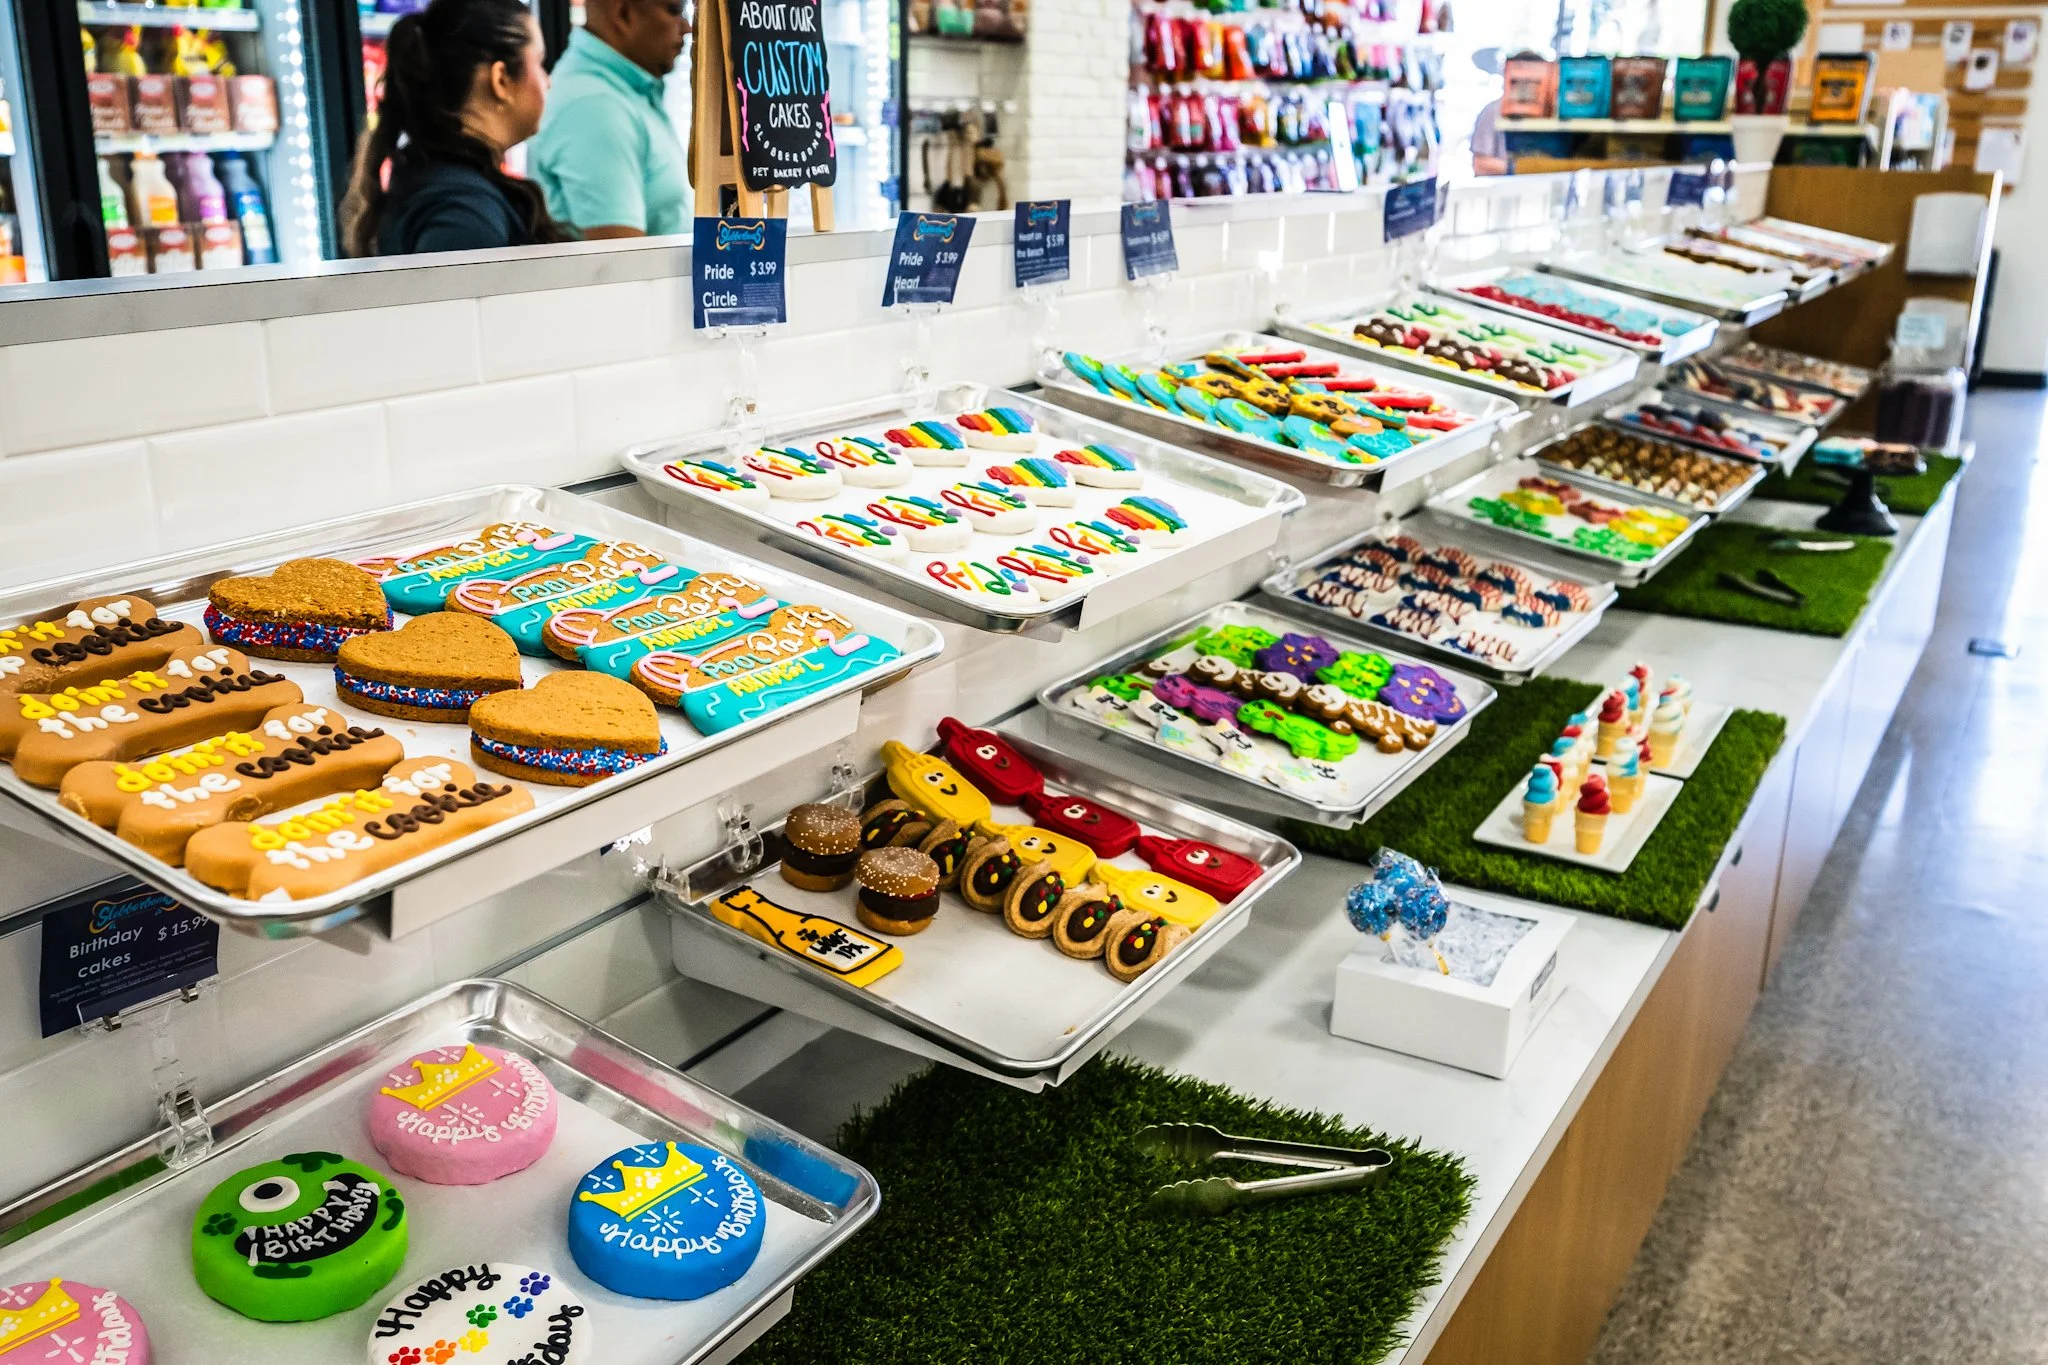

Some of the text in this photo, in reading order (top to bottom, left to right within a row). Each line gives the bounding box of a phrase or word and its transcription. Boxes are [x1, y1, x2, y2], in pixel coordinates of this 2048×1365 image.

[740, 1, 817, 32] ABOUT OUR
[744, 40, 825, 97] CUSTOM
[769, 103, 811, 128] CAKES
[752, 167, 769, 177] PET
[811, 164, 830, 176] BATH
[704, 263, 735, 280] Pride
[899, 252, 924, 266] Pride
[894, 275, 920, 289] Heart
[702, 291, 738, 308] Circle
[397, 552, 472, 573] POOL
[511, 540, 664, 602] POOL Party
[66, 599, 132, 630] for
[612, 573, 760, 633] POOL Party
[700, 607, 853, 680] POOL Party
[167, 647, 230, 679] for
[37, 704, 140, 739] the
[263, 707, 329, 741] for
[140, 772, 242, 810] the
[381, 762, 453, 797] for
[265, 782, 514, 870] the cookie
[69, 926, 143, 959] Birthday
[77, 952, 132, 978] cakes
[396, 1052, 549, 1145] Happy Birthday
[262, 1194, 352, 1239] HAPPY
[599, 1155, 757, 1260] Happy Birthday
[374, 1262, 502, 1339] Happy
